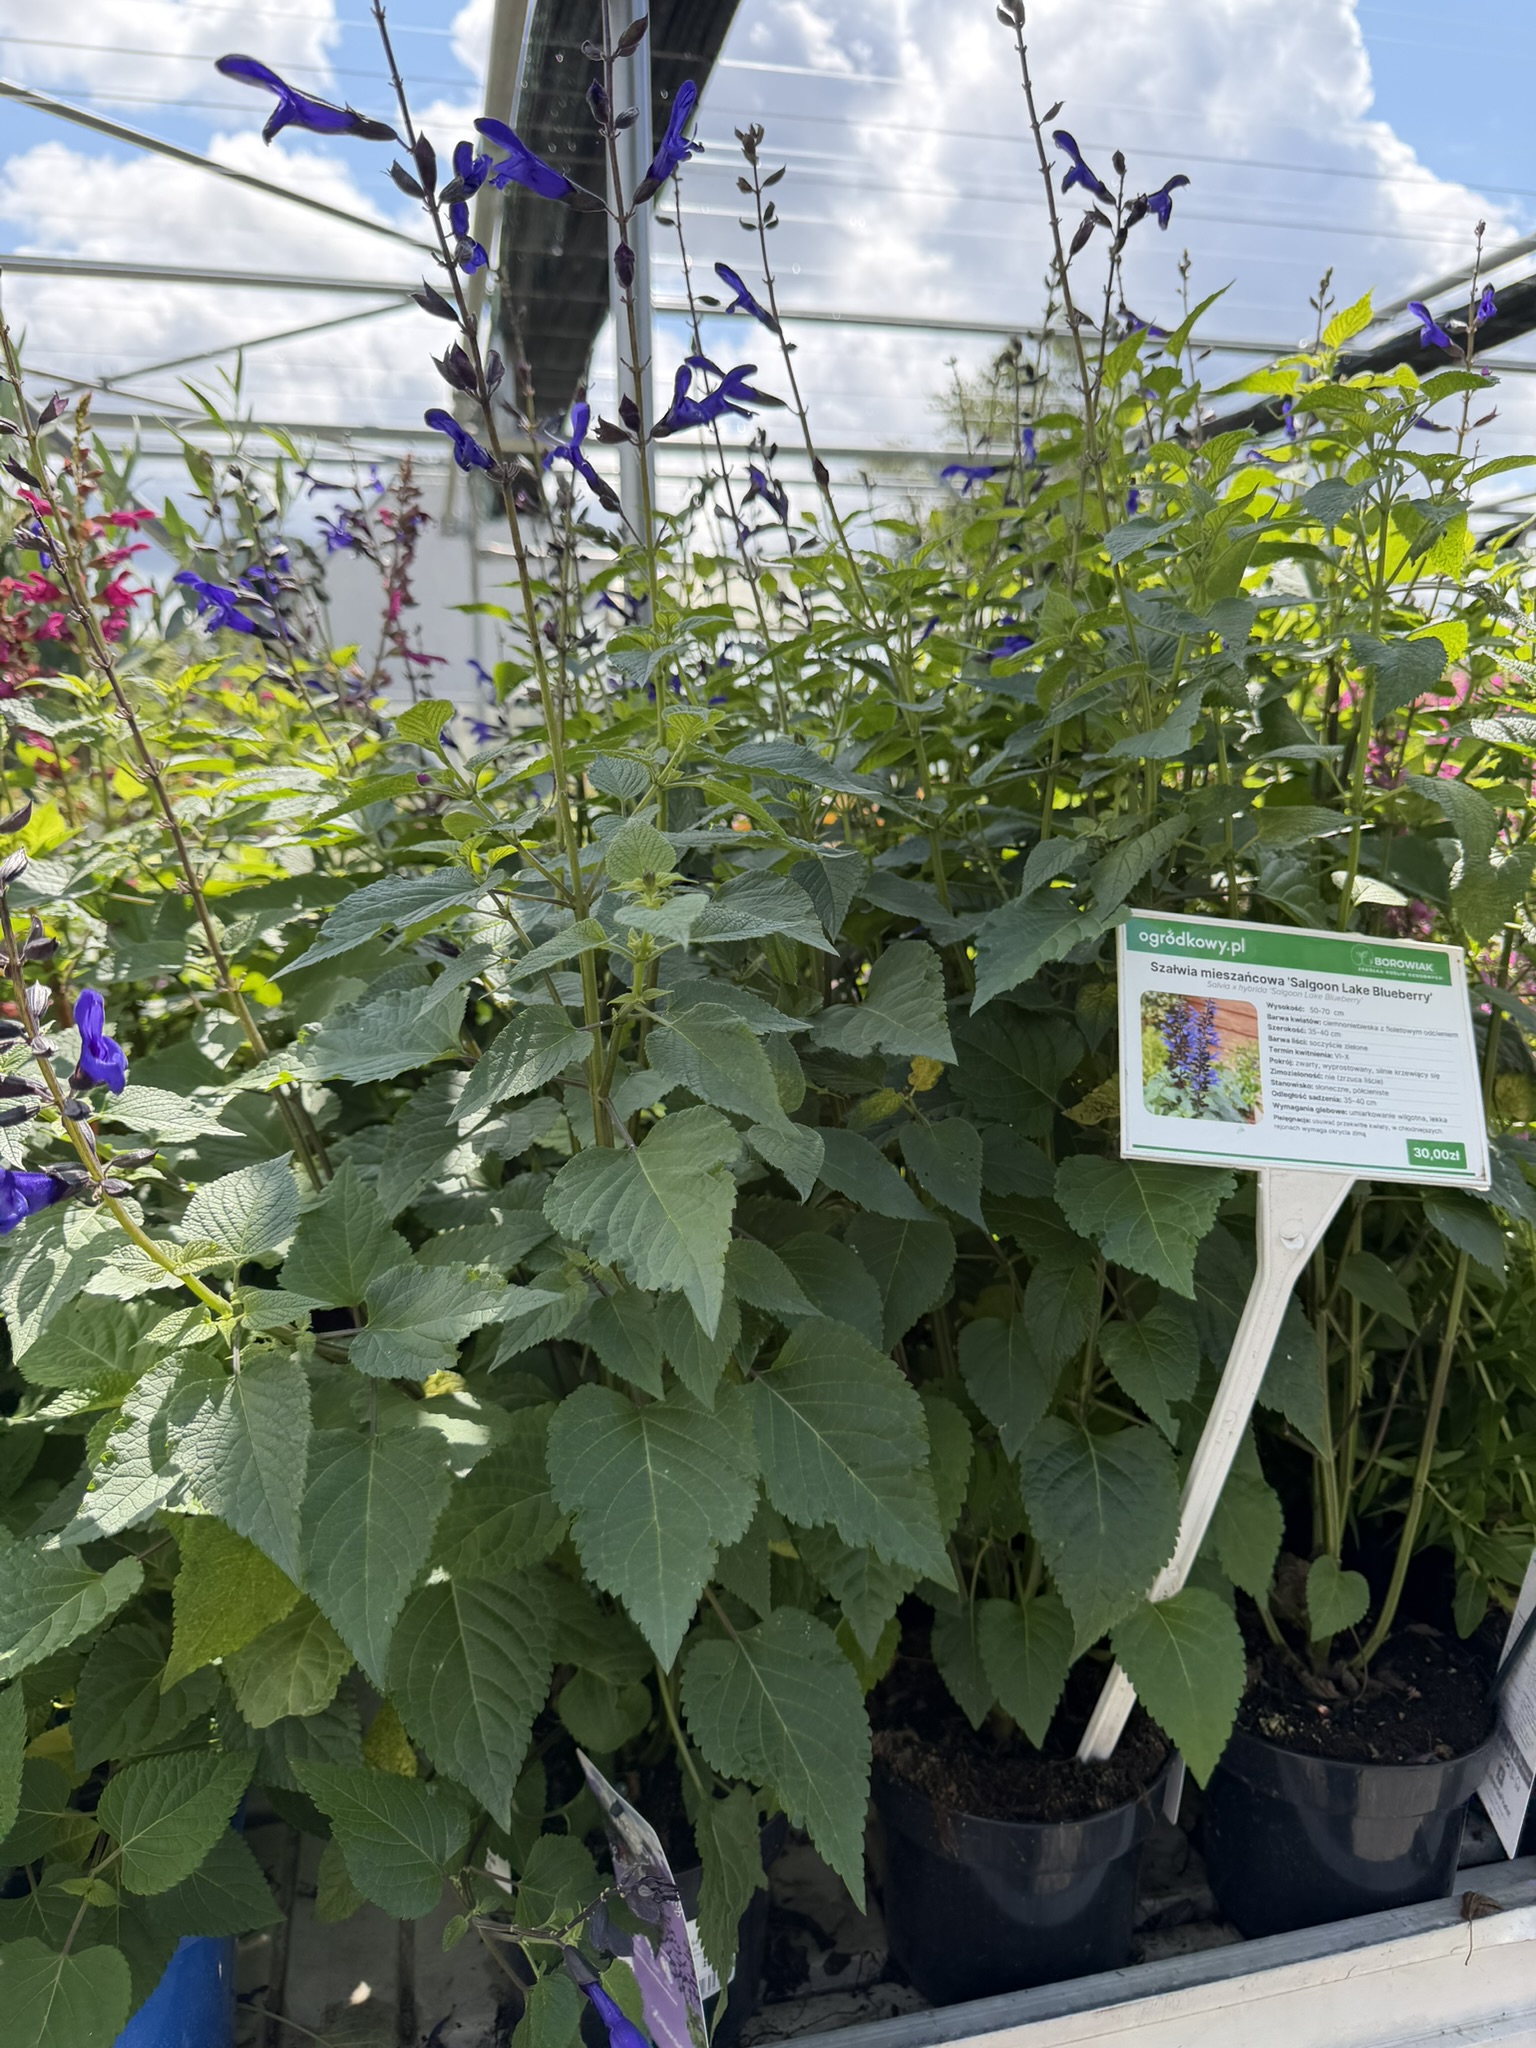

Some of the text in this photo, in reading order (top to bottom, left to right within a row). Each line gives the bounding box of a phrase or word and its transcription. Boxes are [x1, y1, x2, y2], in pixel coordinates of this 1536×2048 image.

[1139, 928, 1245, 956] ogródkowy.pl
[1374, 957, 1433, 971] BOROWIAK
[1151, 962, 1432, 1003] Szałwia mieszańcowa 'Salgoon Lake Blueberry'
[1207, 981, 1230, 990] Salvia
[1238, 985, 1267, 994] hybrida
[1266, 1002, 1304, 1012] Wysokość:
[1291, 1016, 1321, 1025] kwiatów:
[1268, 1024, 1306, 1034] Szerokość:
[1308, 1028, 1329, 1036] 35-40
[1295, 1050, 1333, 1058] kwitnienia:
[1269, 1057, 1294, 1066] Pokrój:
[1270, 1068, 1323, 1079] Zimozieloność:
[1271, 1079, 1313, 1089] Stanowisko:
[1271, 1090, 1307, 1099] Odległość
[1272, 1102, 1314, 1112] Wymagania
[1413, 1147, 1460, 1161] 30,00zł
